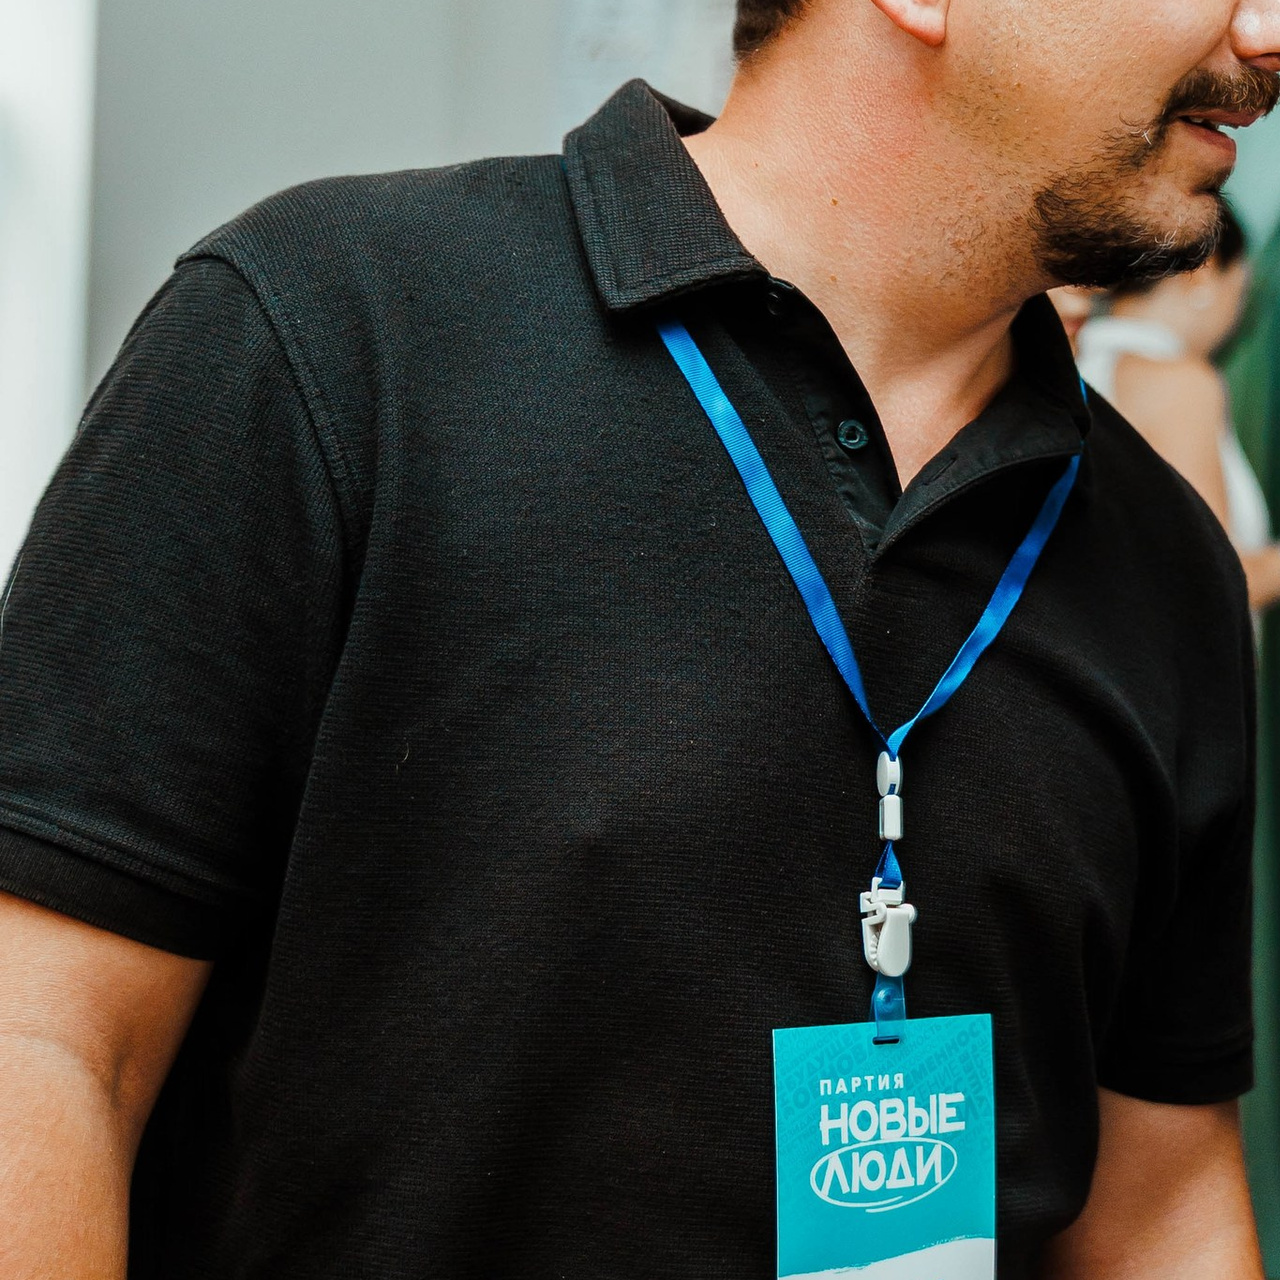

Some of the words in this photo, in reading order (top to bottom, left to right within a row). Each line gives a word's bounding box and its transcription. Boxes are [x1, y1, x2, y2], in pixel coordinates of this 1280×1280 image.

[819, 1073, 904, 1096] ПАРТИЯ
[819, 1092, 966, 1145] НОВЫЕ
[821, 1143, 944, 1198] ЛЮДИ
